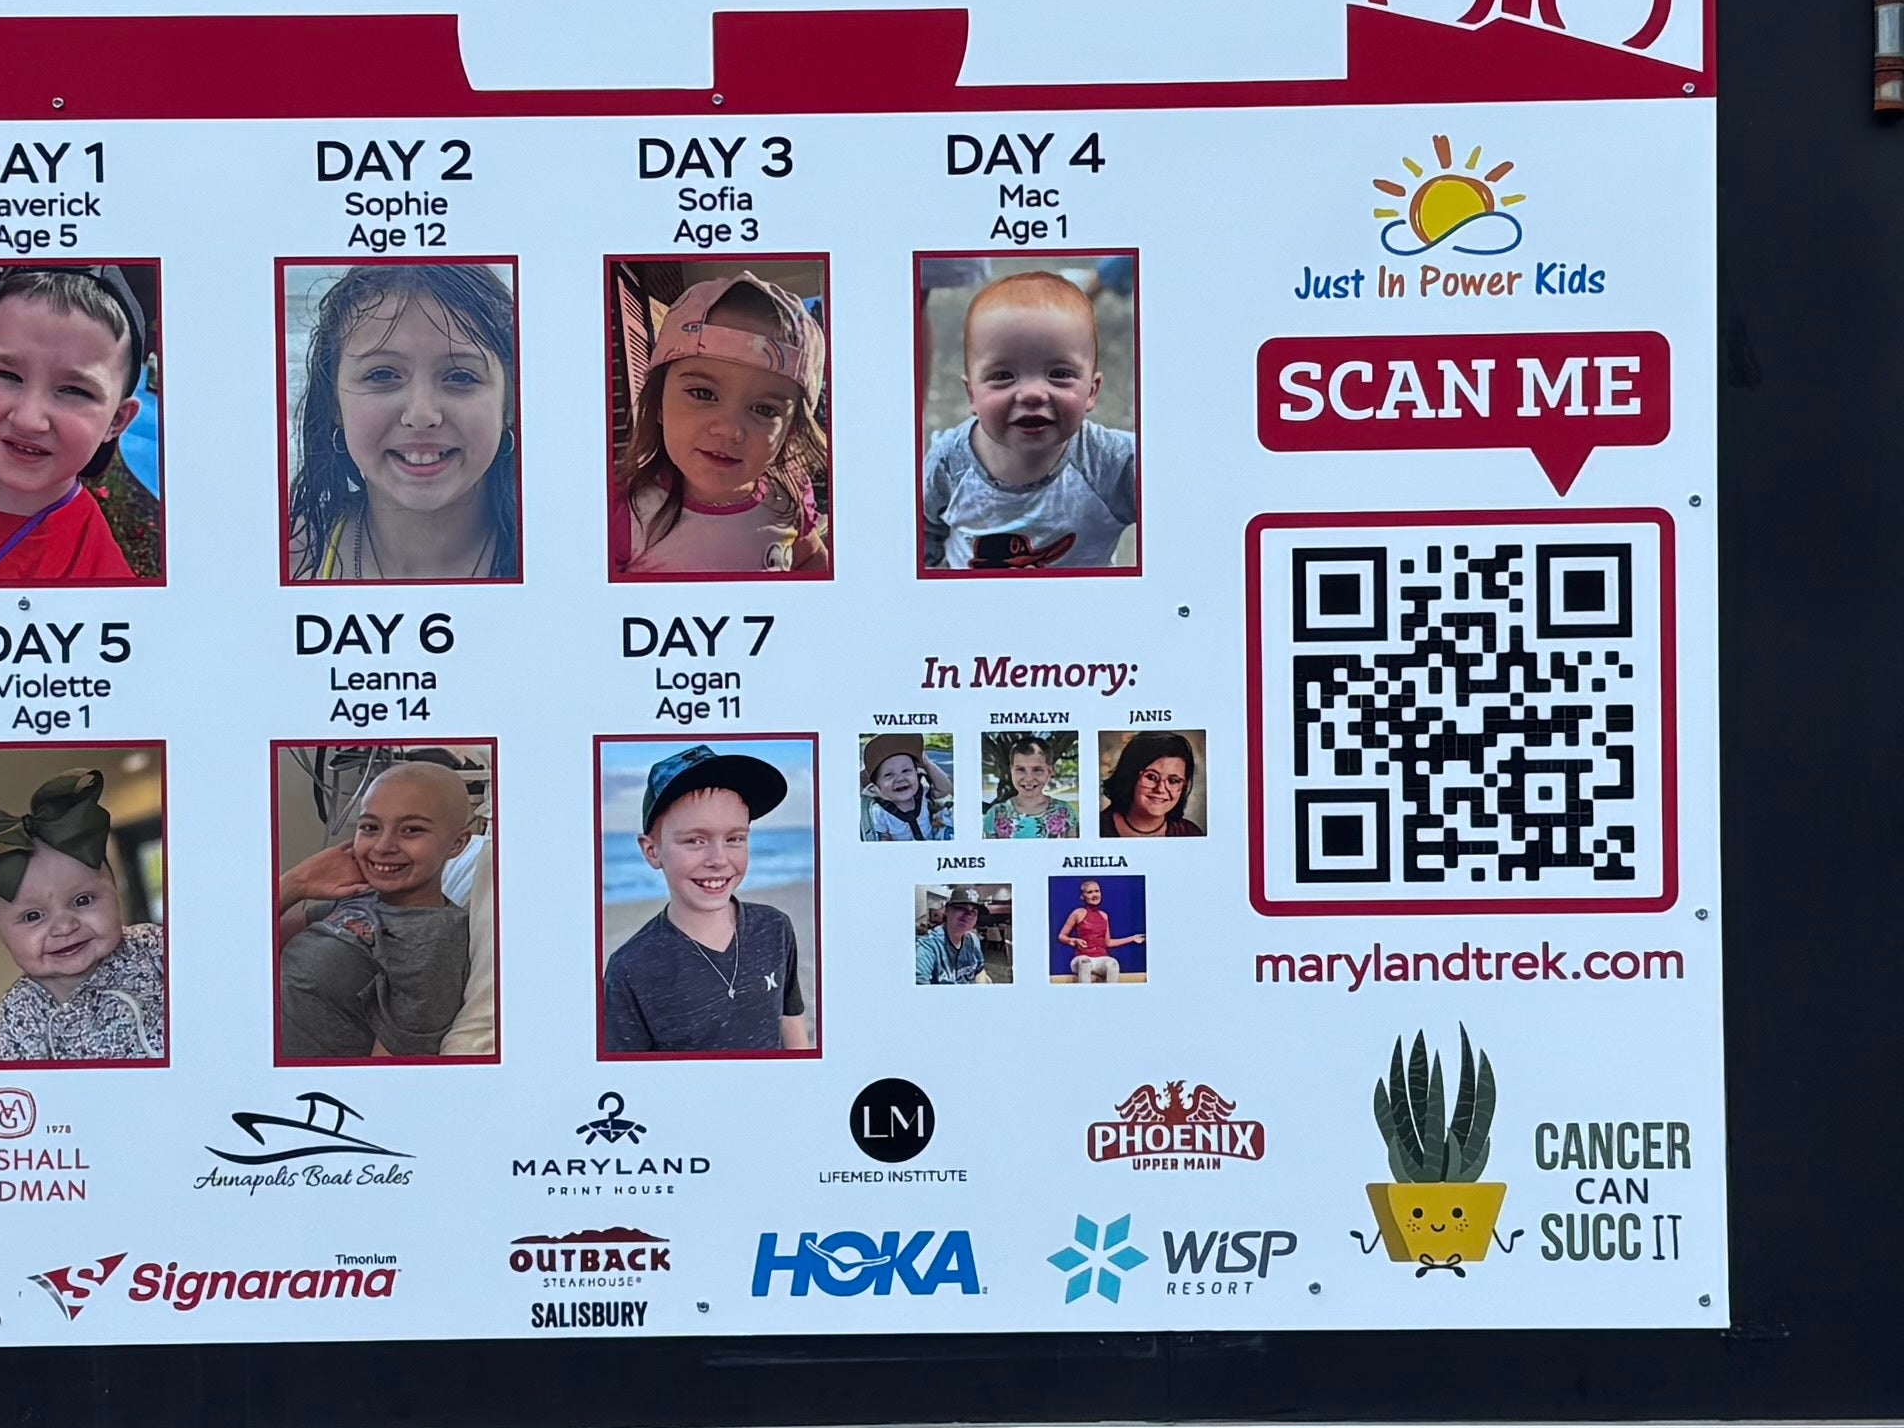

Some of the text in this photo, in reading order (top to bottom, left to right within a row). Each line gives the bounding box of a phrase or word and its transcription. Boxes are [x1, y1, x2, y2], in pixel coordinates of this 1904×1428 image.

[84, 141, 104, 184] 1
[317, 139, 473, 182] DAY 2
[638, 136, 793, 179] DAY 3
[947, 132, 1106, 176] DAY 4
[345, 190, 448, 223] Sophie
[678, 185, 753, 212] Sofia
[999, 183, 1060, 209] Mac
[347, 222, 447, 254] Age 12
[1294, 261, 1606, 300] Just In Power Kids
[1278, 355, 1641, 422] SCAN ME
[99, 622, 131, 664] 5
[296, 612, 455, 656] DAY 6
[622, 615, 775, 658] DAY 7
[330, 666, 437, 691] Leanna
[655, 667, 741, 696] Logan
[920, 656, 1138, 697] In Memory:
[329, 696, 431, 728] Age 14
[655, 695, 740, 725] Age 11
[872, 713, 939, 726] WALKER
[989, 711, 1070, 725] EMMALYN
[1129, 709, 1172, 725] JANIS
[936, 856, 986, 872] JAMES
[1062, 855, 1128, 868] ARIELLA
[1255, 941, 1684, 993] marylandtrek.com
[46, 1124, 72, 1134] 1978
[862, 1105, 925, 1138] LM
[1094, 1124, 1257, 1157] PHOENIX
[1535, 1121, 1692, 1171] CANCER
[193, 1163, 414, 1197] Annapolis Boat Sales
[512, 1157, 711, 1177] MARYLAND
[819, 1169, 968, 1184] LIFEMED INSTITUTE
[1132, 1157, 1222, 1172] UPPER MAIN
[547, 1185, 674, 1196] PRINT HOUSE
[1575, 1177, 1649, 1205] CAN
[1540, 1212, 1682, 1262] SUCC IT
[334, 1253, 397, 1265] Timonium
[509, 1247, 671, 1272] OUTBACK
[752, 1230, 981, 1298] HOKA
[128, 1261, 396, 1312] Signarama
[1166, 1281, 1254, 1296] RESORT
[531, 1301, 648, 1329] SALISBURY
